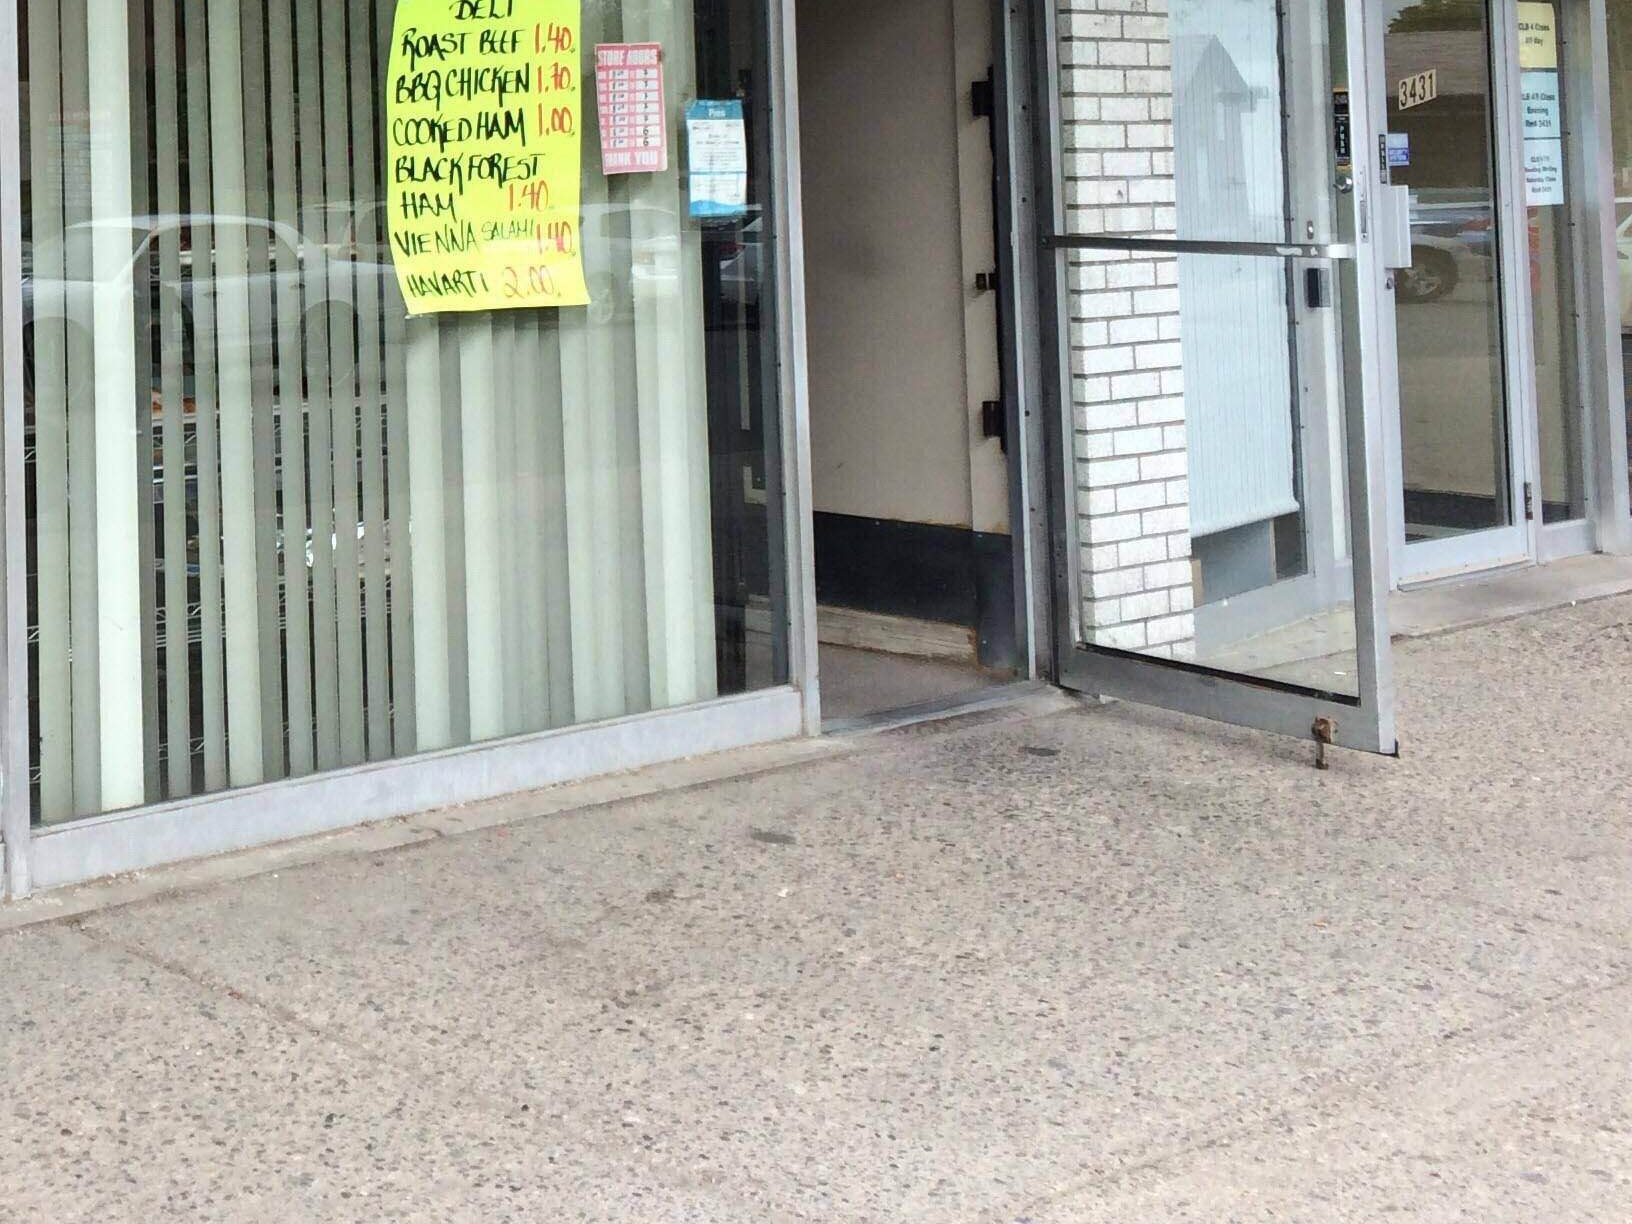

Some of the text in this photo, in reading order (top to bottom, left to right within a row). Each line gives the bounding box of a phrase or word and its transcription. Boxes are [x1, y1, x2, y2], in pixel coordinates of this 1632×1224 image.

[401, 27, 473, 72] ROAST
[479, 28, 526, 55] BEEF
[395, 70, 441, 111] BBQ
[445, 62, 530, 108] CHICKEN
[1400, 72, 1435, 108] 3431
[393, 113, 472, 153] COOKED
[476, 107, 526, 147] HAM
[395, 152, 546, 195] BLACK FOREST
[400, 191, 458, 222] HAM
[394, 219, 479, 258] VIENNA
[406, 269, 489, 298] HAVARTI
